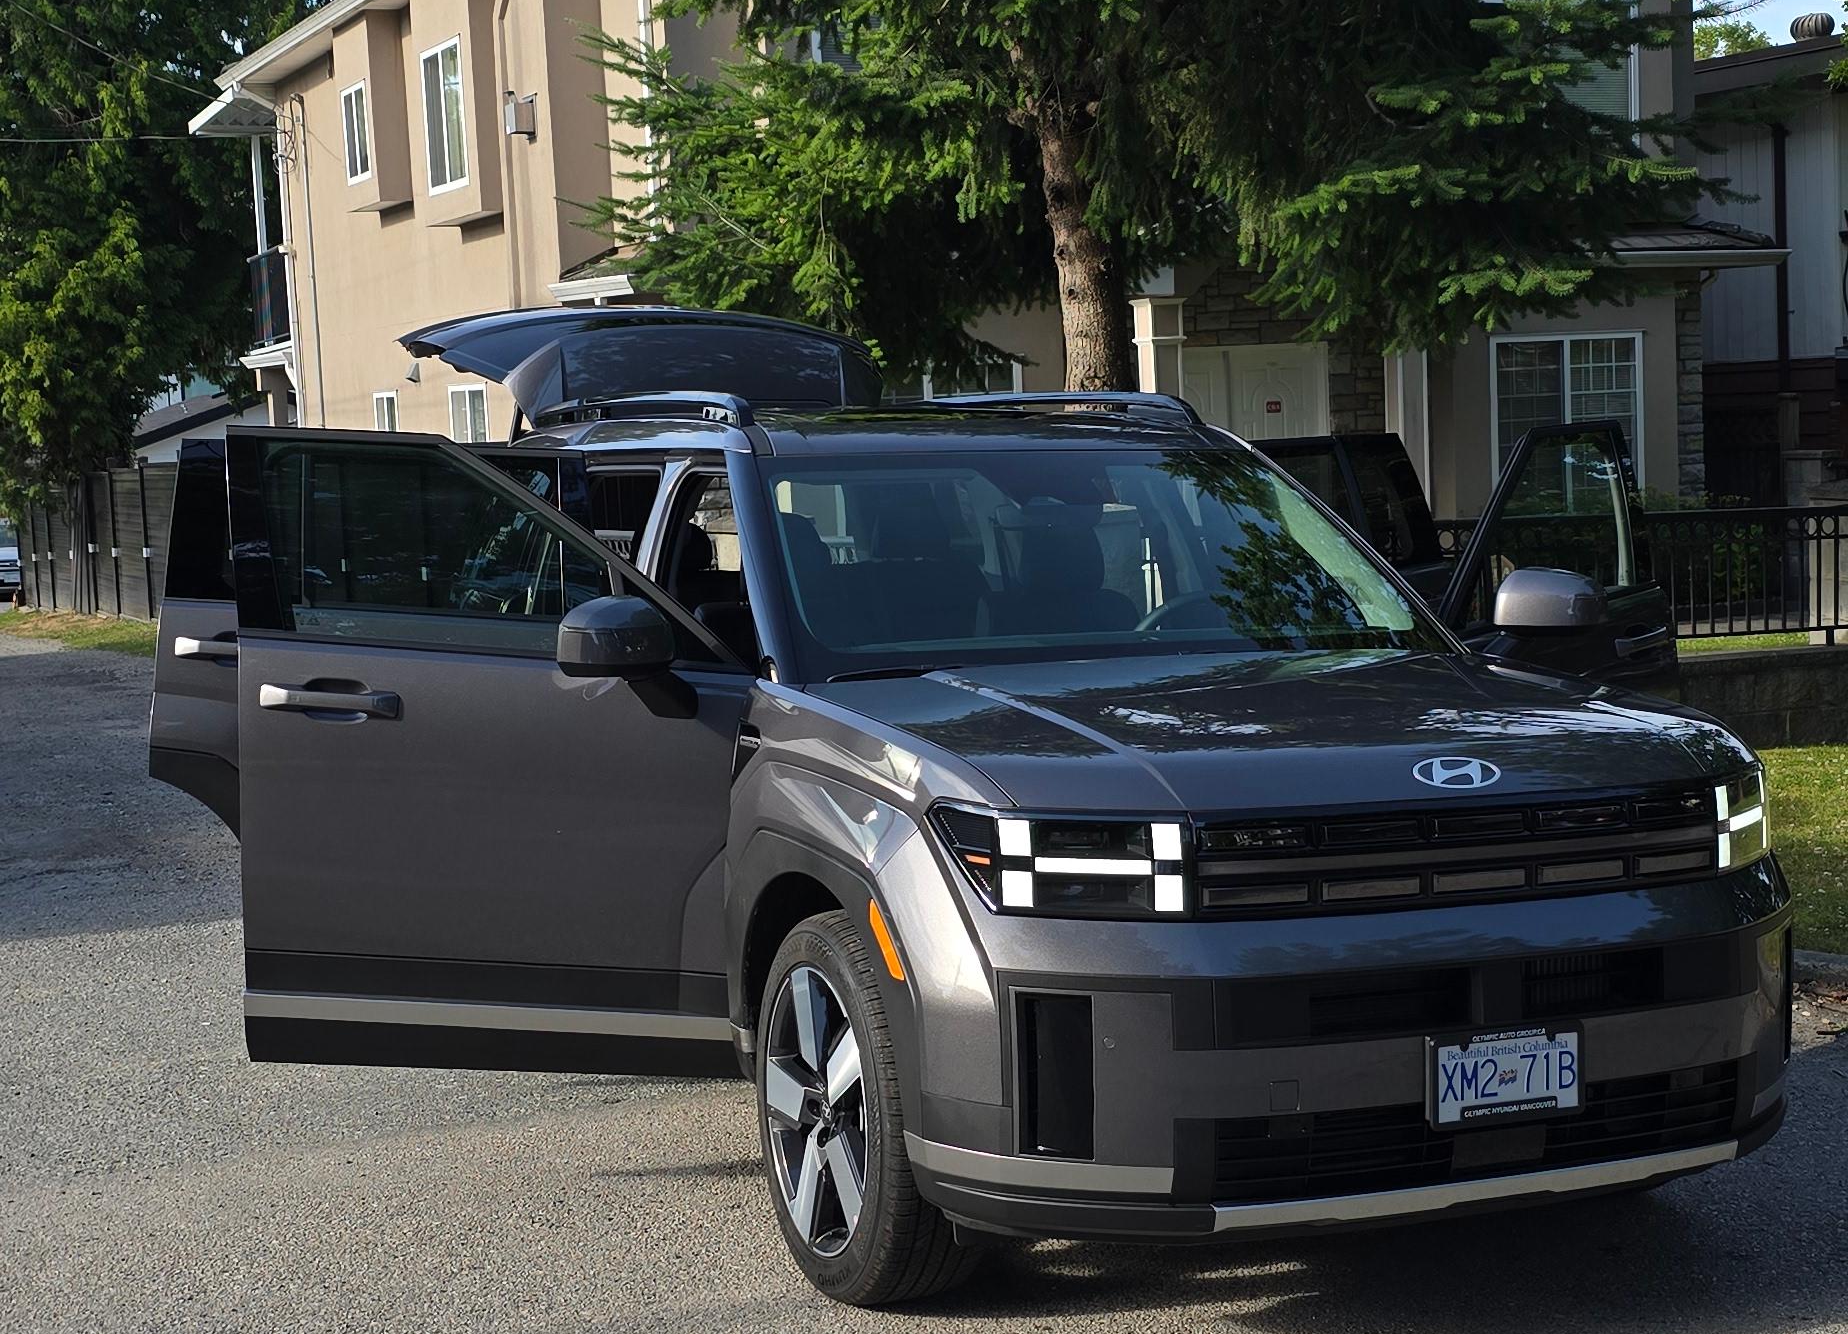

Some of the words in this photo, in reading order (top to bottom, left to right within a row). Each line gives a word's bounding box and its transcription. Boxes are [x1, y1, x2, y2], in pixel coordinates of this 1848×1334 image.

[1472, 1033, 1499, 1043] OLYMPIC
[1499, 1031, 1516, 1039] AUTO
[1447, 1046, 1489, 1061] Beautiful
[1491, 1042, 1521, 1057] British
[1522, 1039, 1568, 1053] Columbia
[1440, 1058, 1498, 1103] XM2
[1519, 1050, 1576, 1094] 71B
[1464, 1108, 1491, 1118] OLYMPIC
[1491, 1105, 1519, 1114] HYUNDAI
[1519, 1100, 1556, 1111] VANCOUVER
